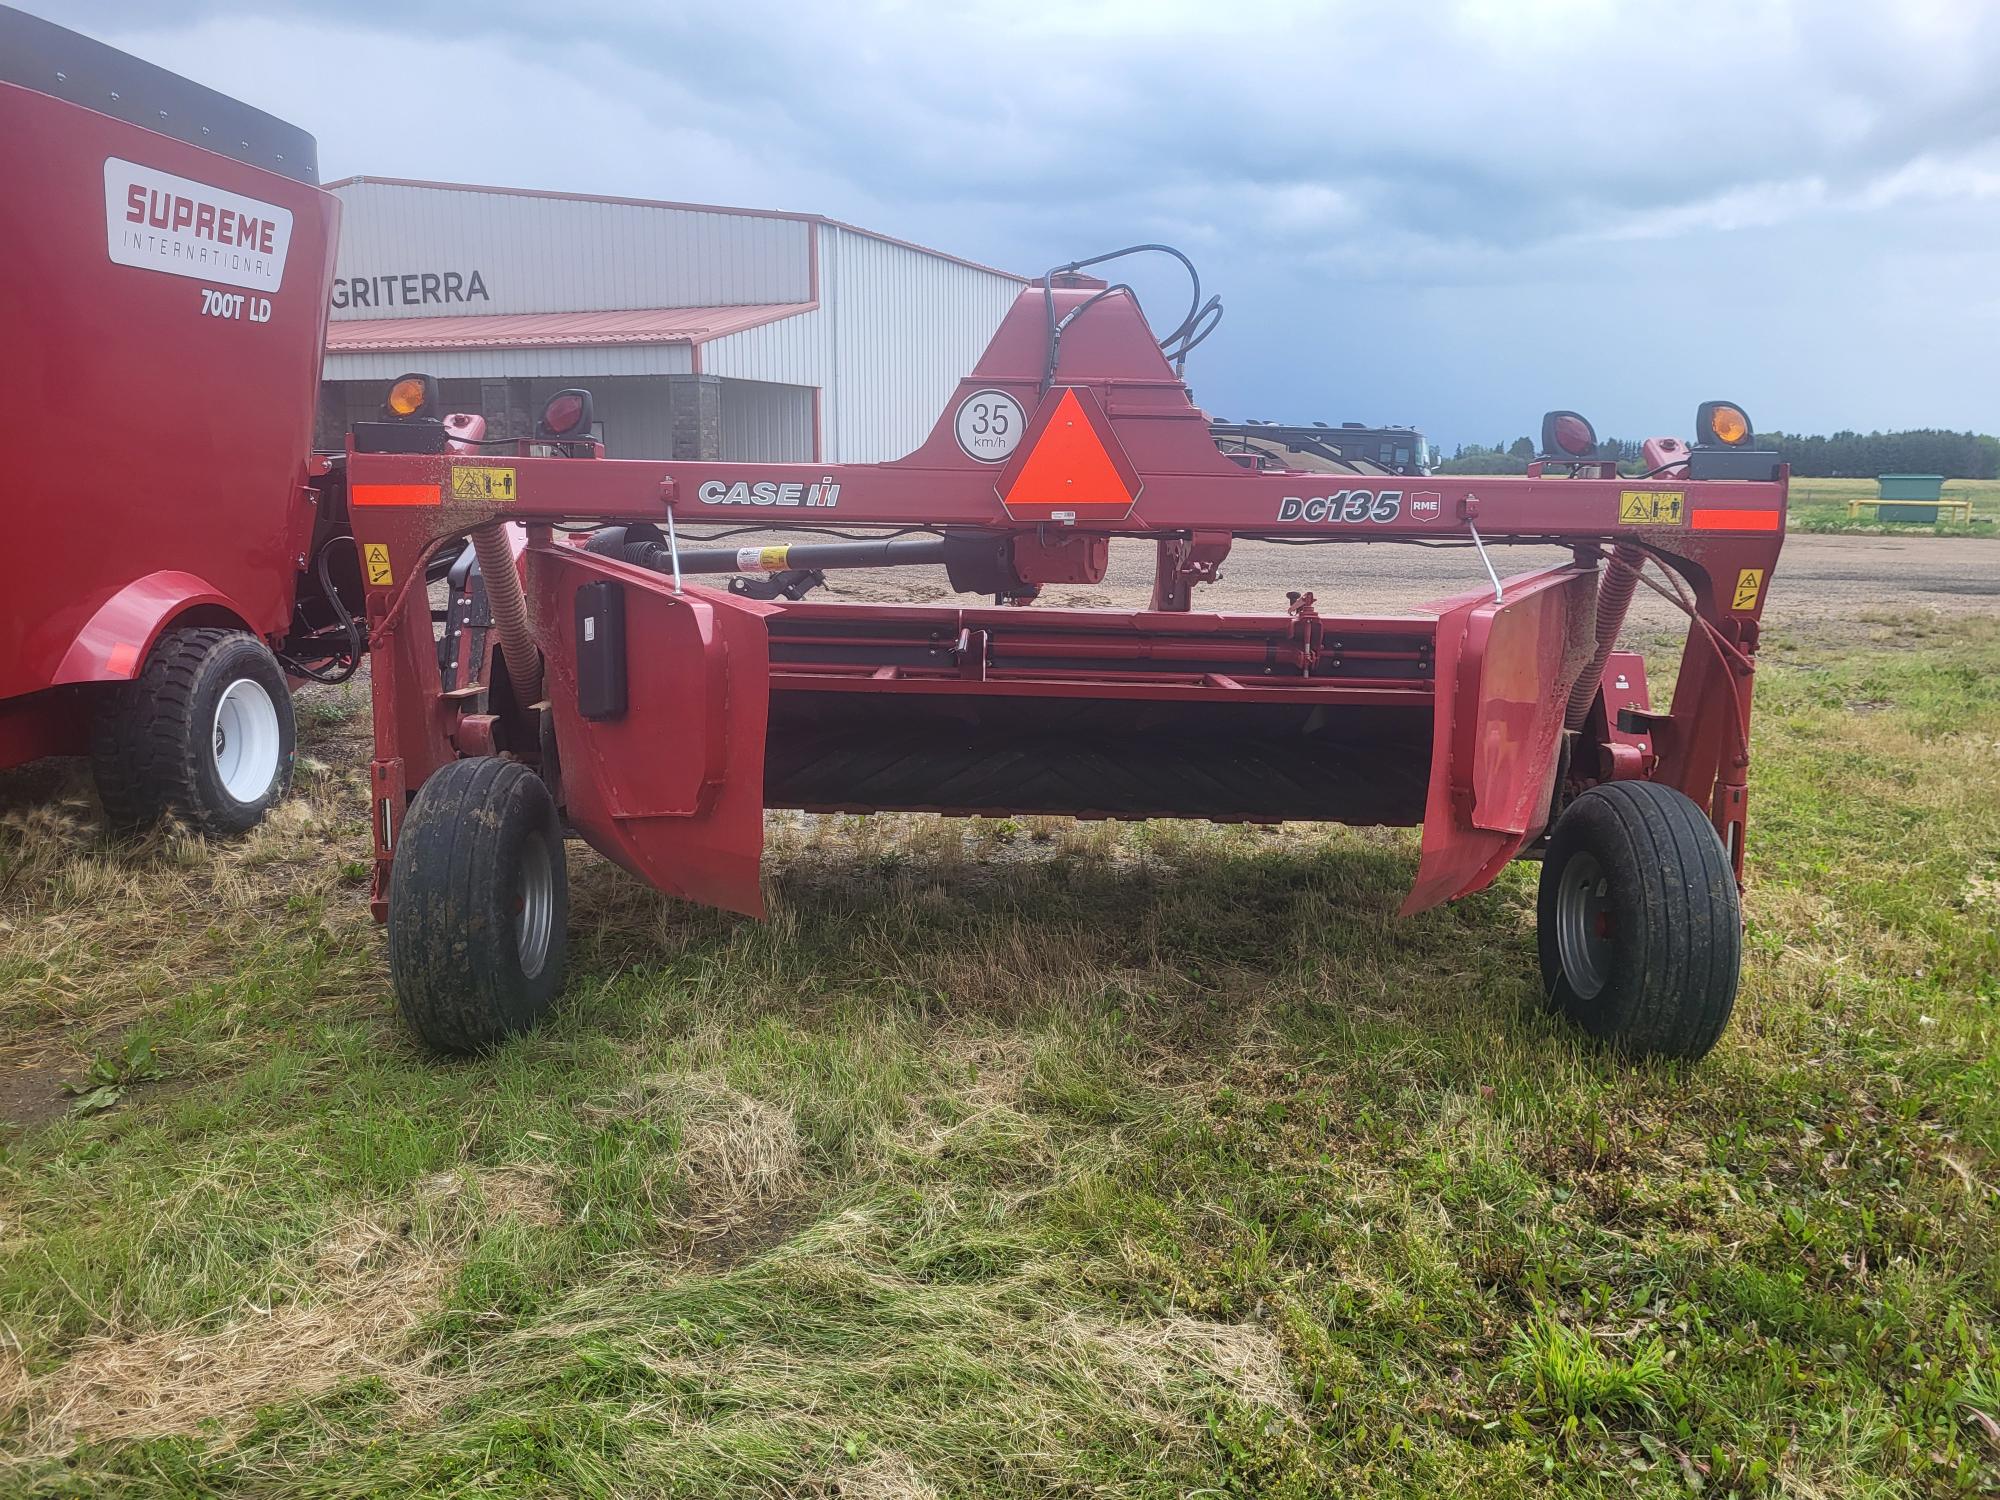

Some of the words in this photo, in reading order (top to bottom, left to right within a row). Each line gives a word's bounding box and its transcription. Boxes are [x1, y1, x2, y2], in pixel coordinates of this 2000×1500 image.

[126, 183, 276, 255] SUPREME
[123, 231, 272, 277] INTERNATIONAL
[201, 289, 245, 320] 700T
[249, 296, 272, 323] LD
[332, 270, 490, 309] GRITERRA
[972, 403, 1009, 435] 35
[974, 436, 1006, 448] km/h
[698, 480, 804, 506] CASE
[1277, 489, 1403, 524] DC135
[1412, 501, 1439, 511] RME
